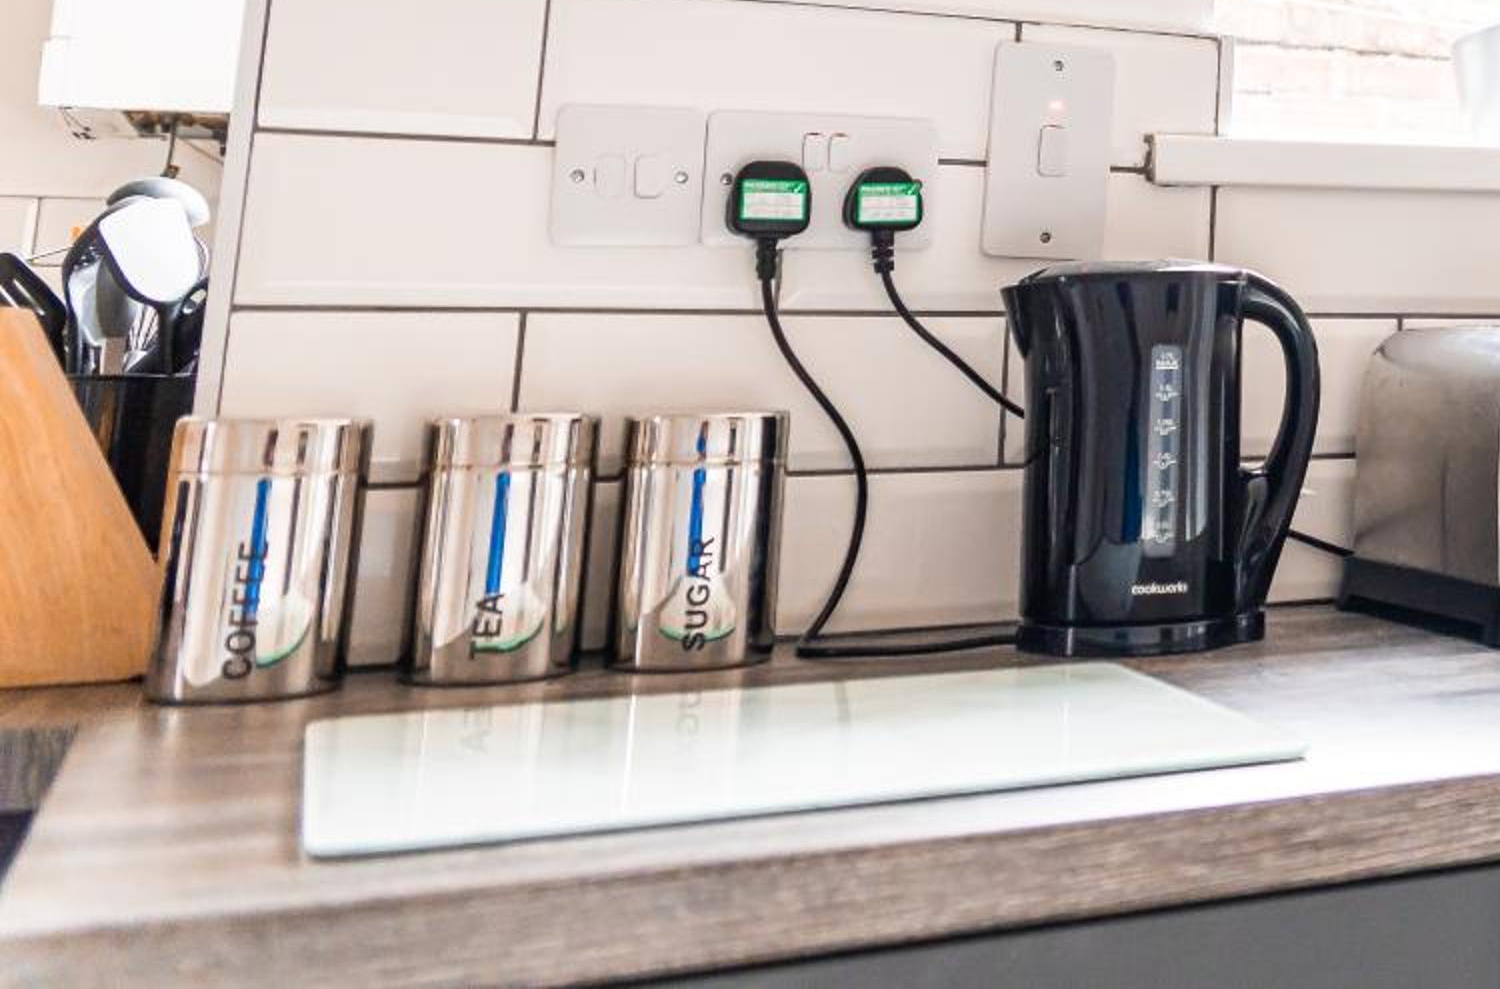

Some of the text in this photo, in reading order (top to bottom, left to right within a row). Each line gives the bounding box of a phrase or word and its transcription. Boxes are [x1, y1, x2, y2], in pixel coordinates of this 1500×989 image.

[222, 541, 268, 680] COFFEE
[469, 593, 504, 660] TEA
[682, 537, 715, 651] SUGAR
[1131, 581, 1188, 596] cookworks
